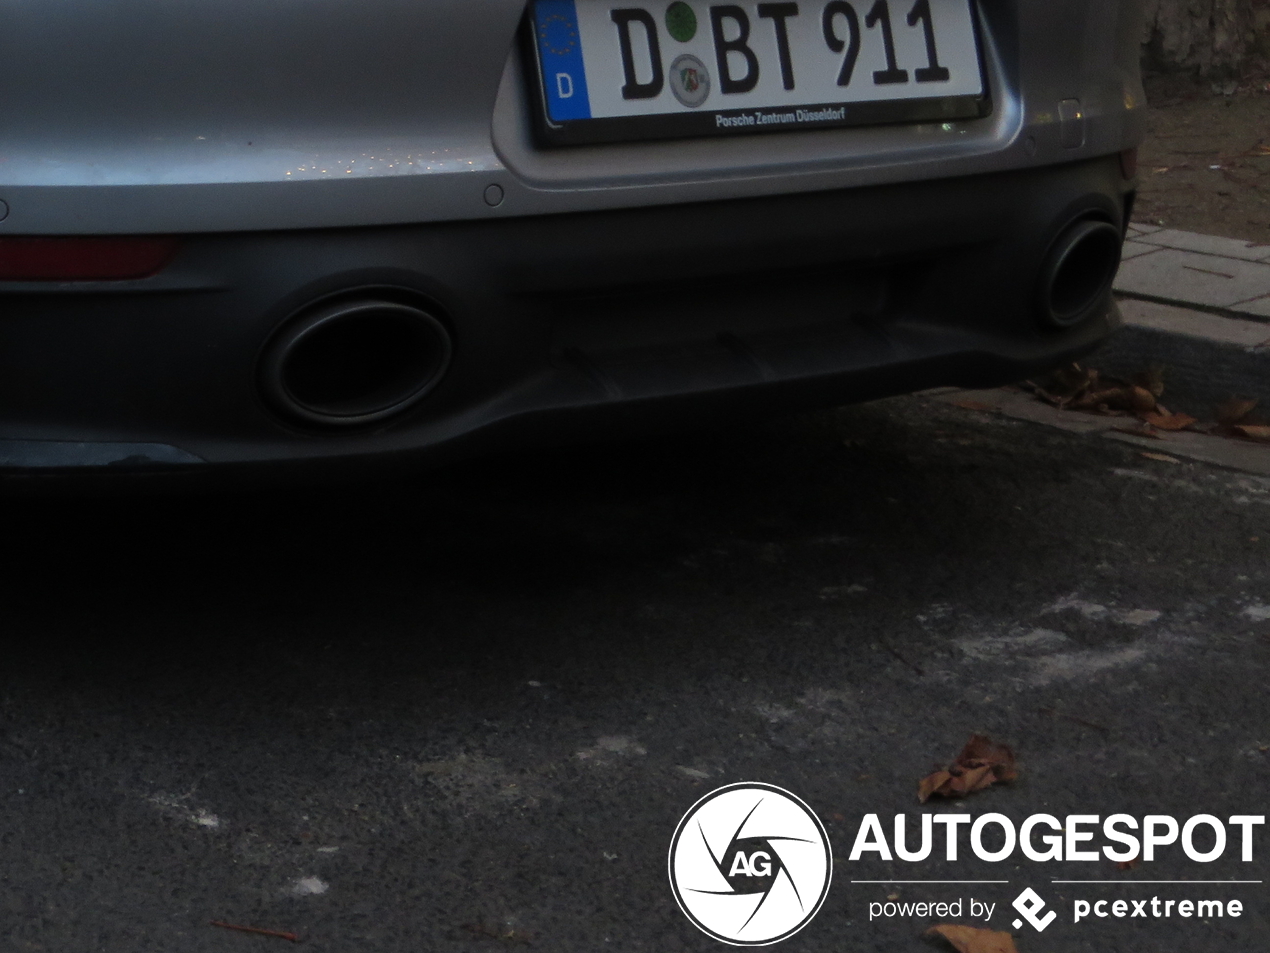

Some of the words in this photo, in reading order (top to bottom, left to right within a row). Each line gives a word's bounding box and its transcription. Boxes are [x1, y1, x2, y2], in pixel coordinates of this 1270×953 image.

[610, 7, 665, 101] D
[709, 1, 800, 95] BT
[556, 73, 574, 99] D
[715, 112, 754, 128] Porsche
[755, 111, 795, 125] Zentrum
[796, 106, 846, 122] Düsseldorf
